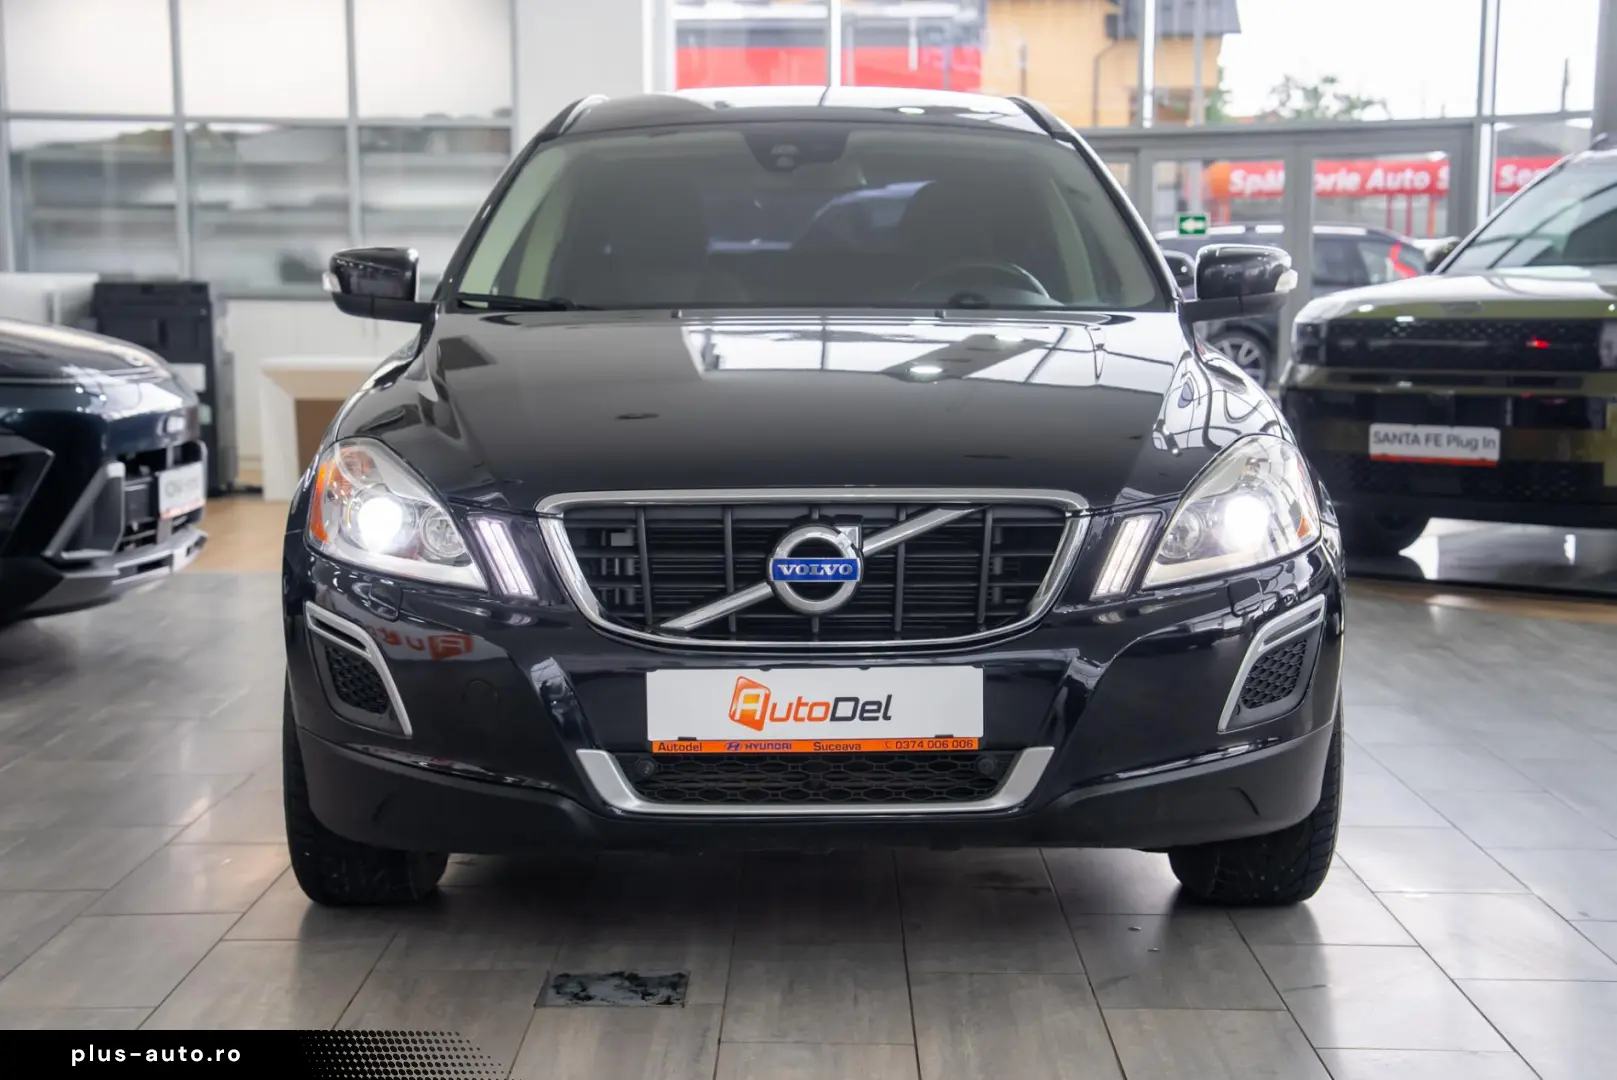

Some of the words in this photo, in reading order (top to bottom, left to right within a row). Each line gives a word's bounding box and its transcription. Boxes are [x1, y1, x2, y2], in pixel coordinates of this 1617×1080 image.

[1365, 168, 1430, 191] Auto
[1372, 431, 1420, 446] SANTA
[1424, 433, 1442, 448] FE
[1446, 434, 1478, 452] Plug
[1482, 436, 1496, 450] In
[777, 564, 853, 576] VOLVO
[732, 686, 893, 724] AutoDel
[657, 742, 703, 752] Autodel
[745, 743, 792, 751] HYUNDAI
[813, 741, 862, 751] Suceava
[895, 740, 924, 750] 0374
[928, 740, 949, 749] 006
[952, 739, 974, 749] 006
